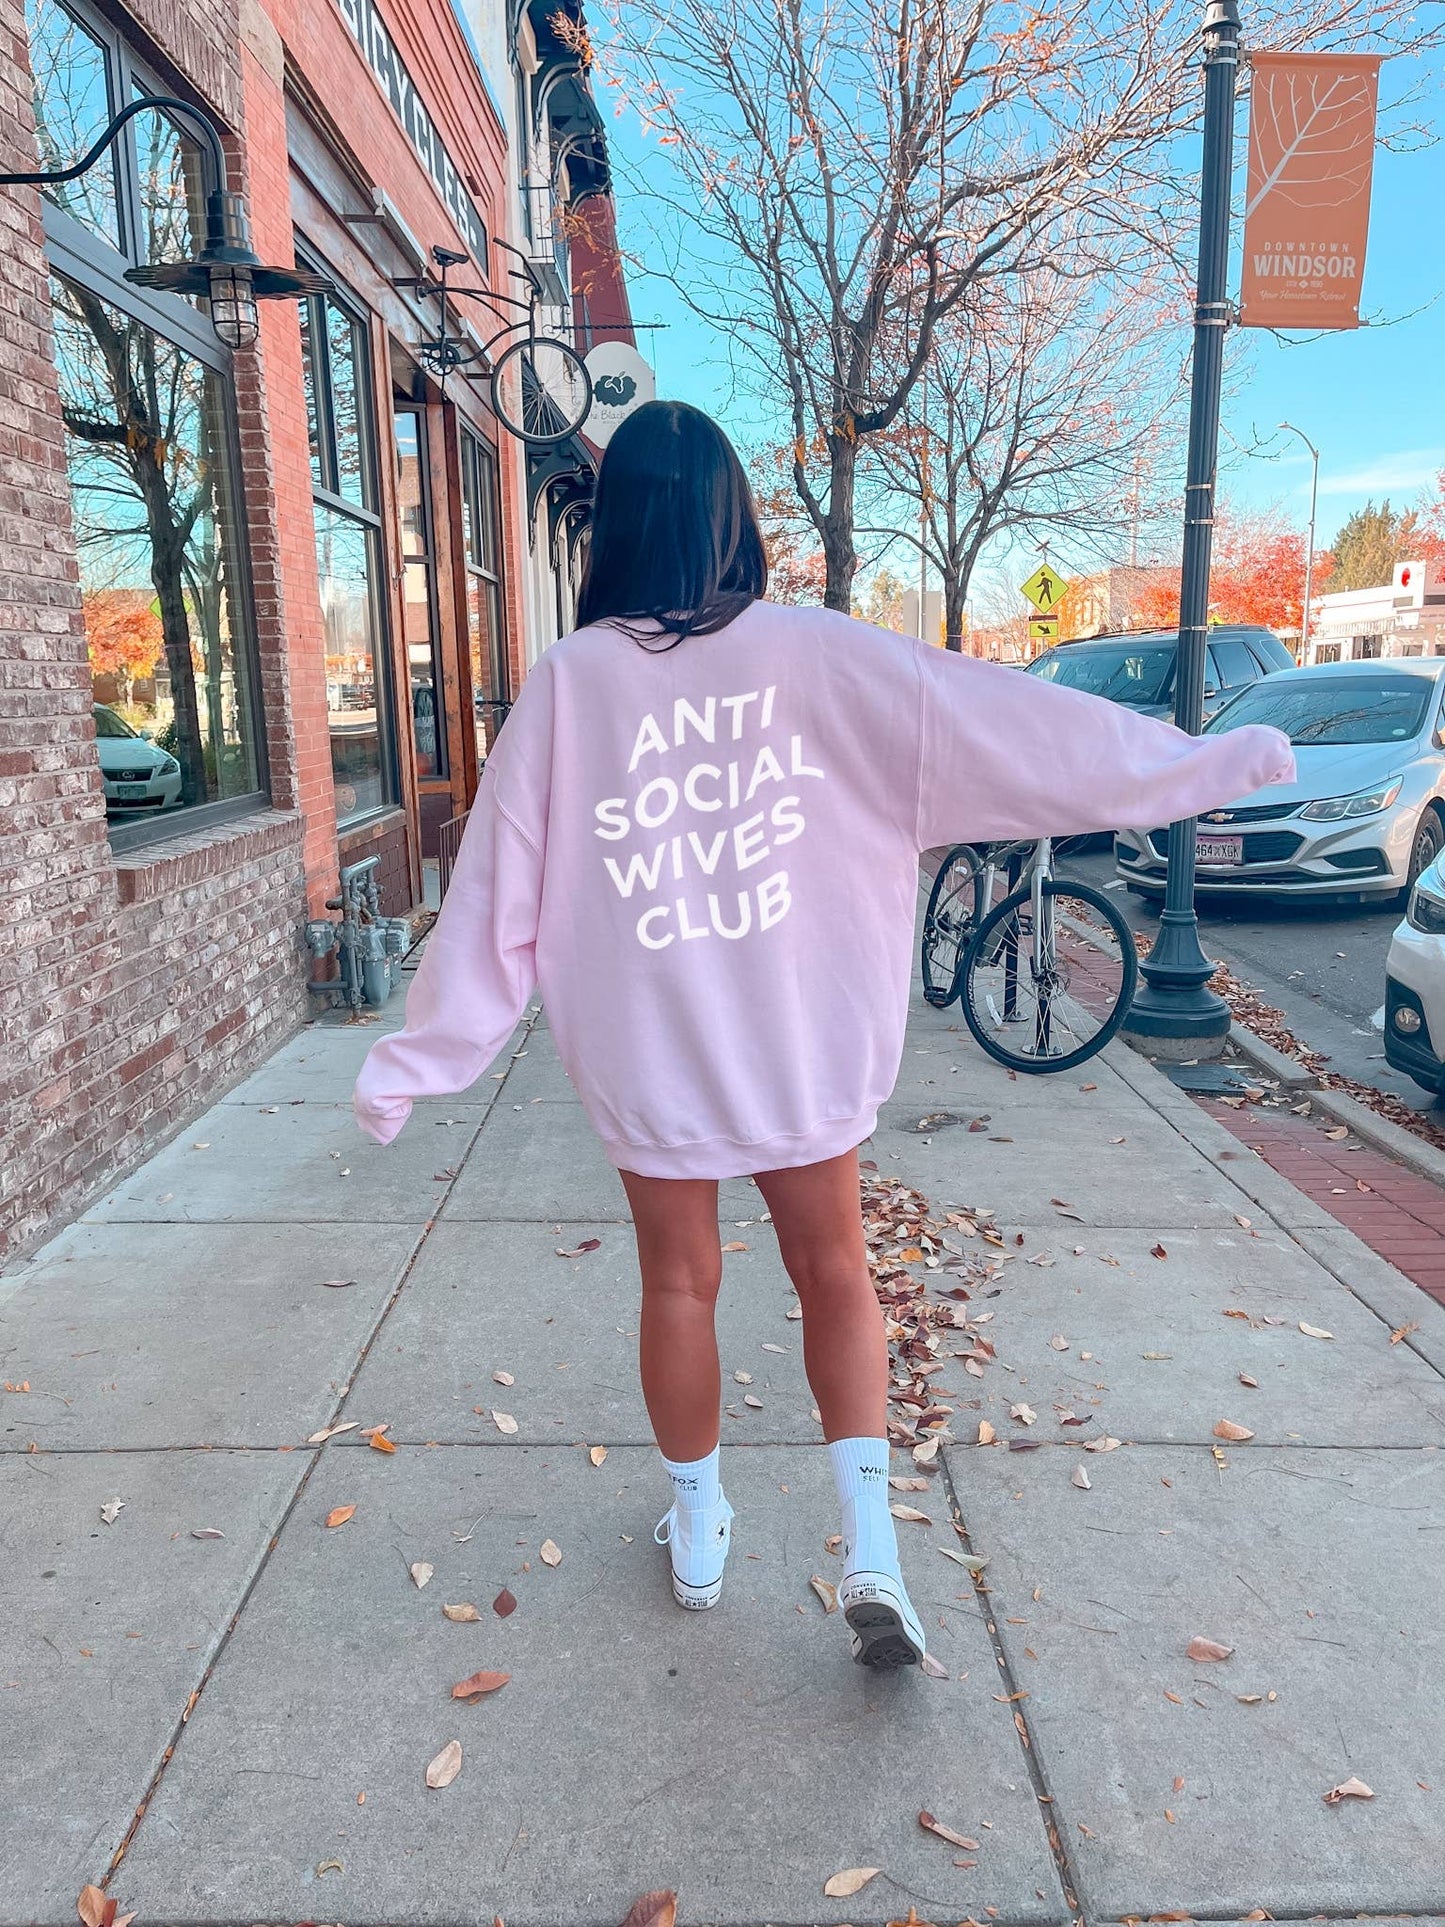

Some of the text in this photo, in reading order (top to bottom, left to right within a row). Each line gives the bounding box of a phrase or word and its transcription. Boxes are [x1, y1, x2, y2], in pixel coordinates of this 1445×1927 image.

[1253, 254, 1356, 278] WINDSOR
[1264, 241, 1349, 253] DOWNTOWN
[628, 685, 776, 774] ANTI
[594, 734, 825, 840] SOCIAL
[603, 796, 806, 898] WIVES
[636, 870, 792, 950] CLUB
